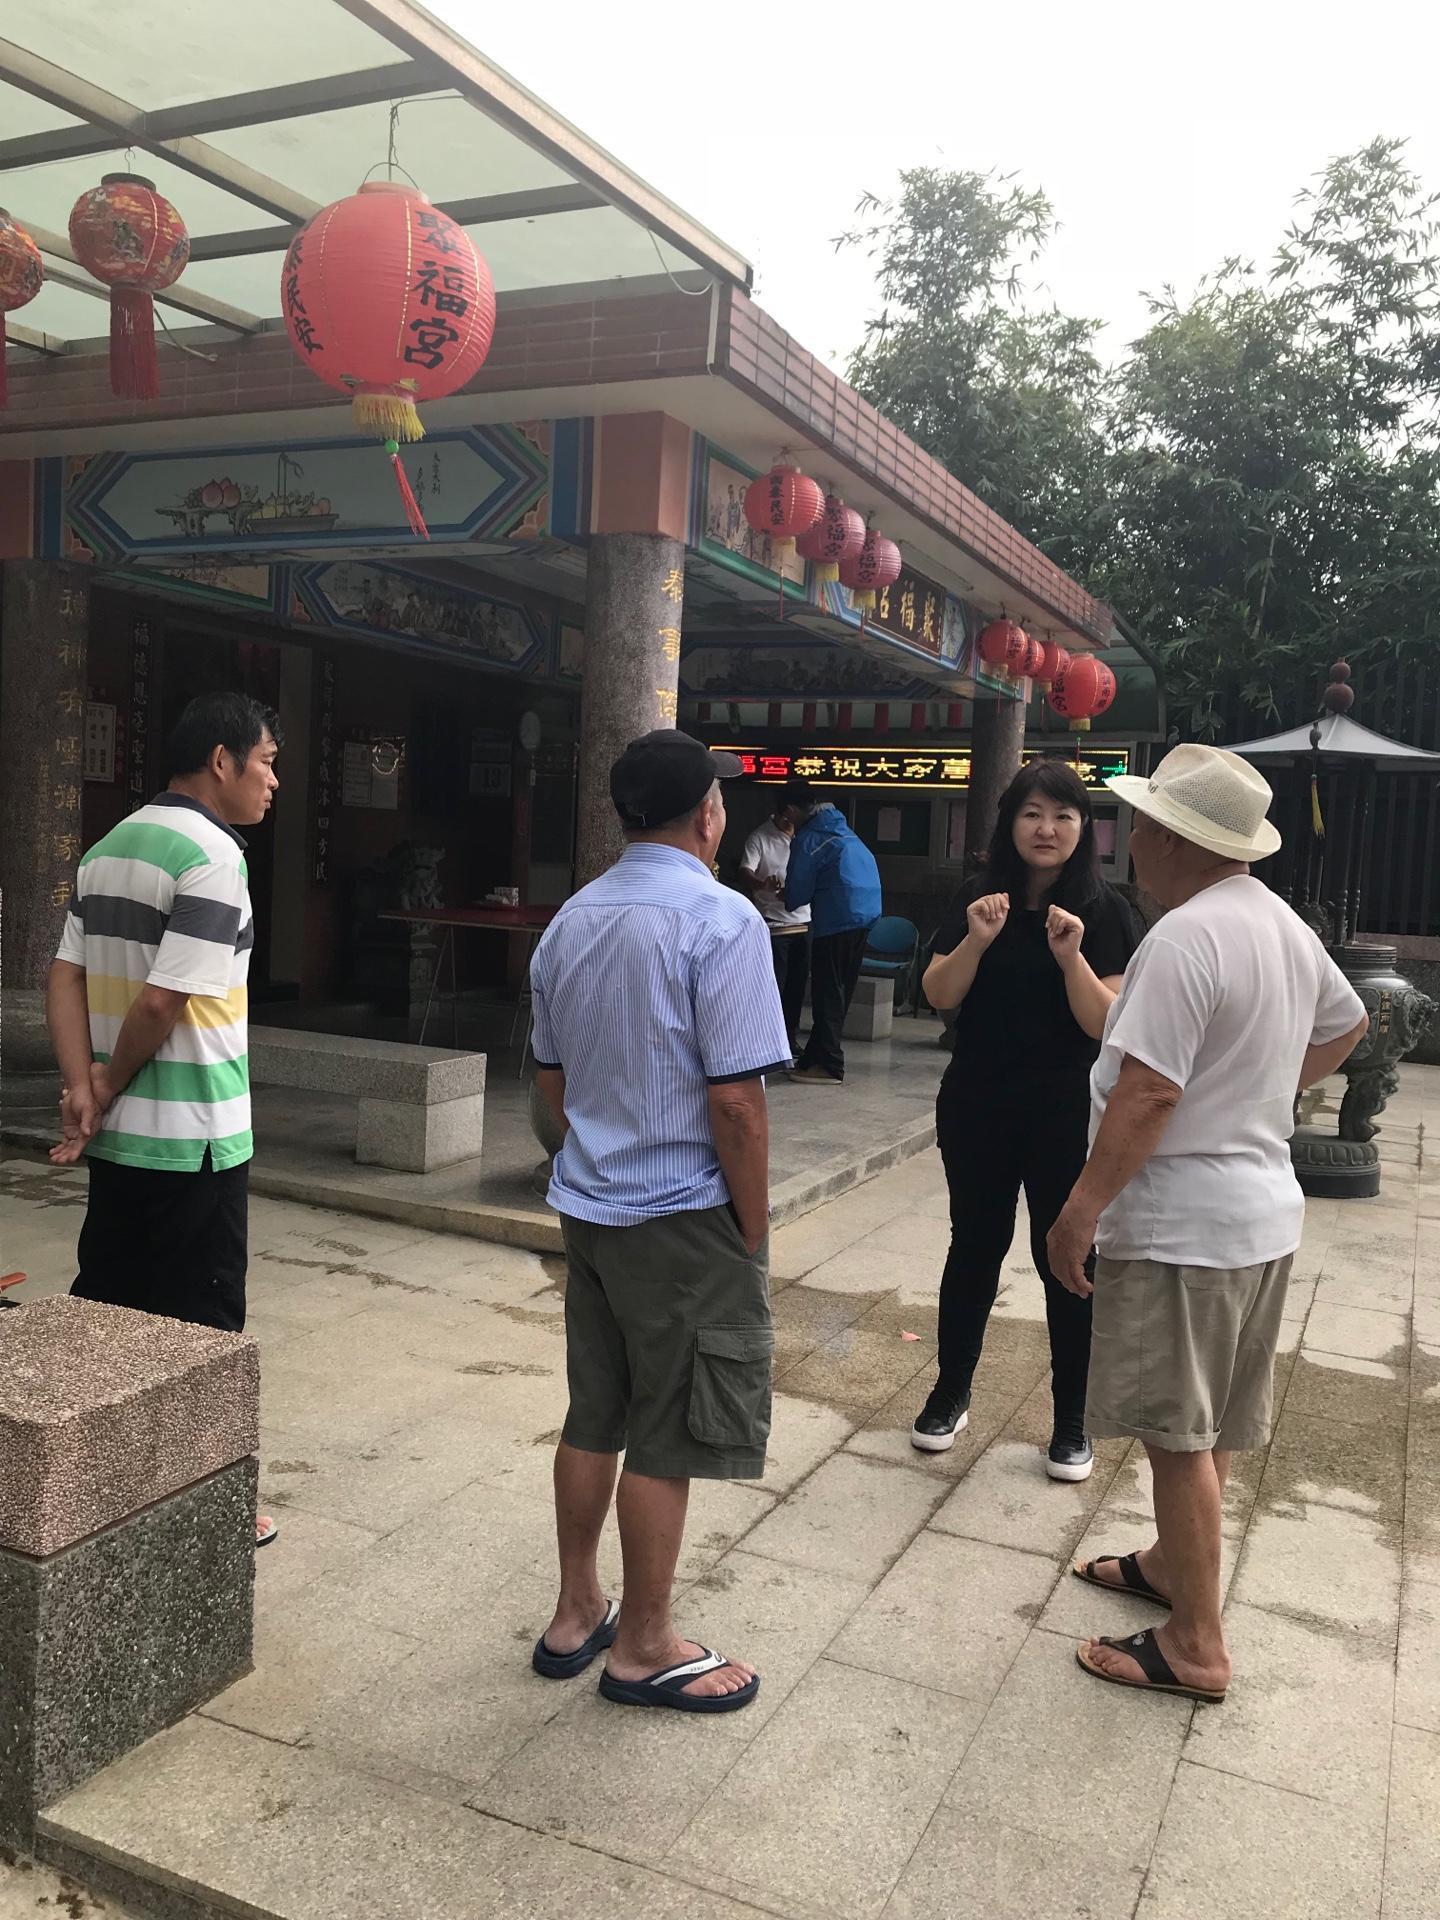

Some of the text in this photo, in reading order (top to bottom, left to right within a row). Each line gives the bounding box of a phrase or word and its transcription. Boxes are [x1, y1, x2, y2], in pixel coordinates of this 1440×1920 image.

[286, 226, 324, 356] 泰民安
[404, 210, 469, 370] 聚福宮
[768, 475, 785, 526] 國泰民安
[823, 506, 847, 557] 聚福宮
